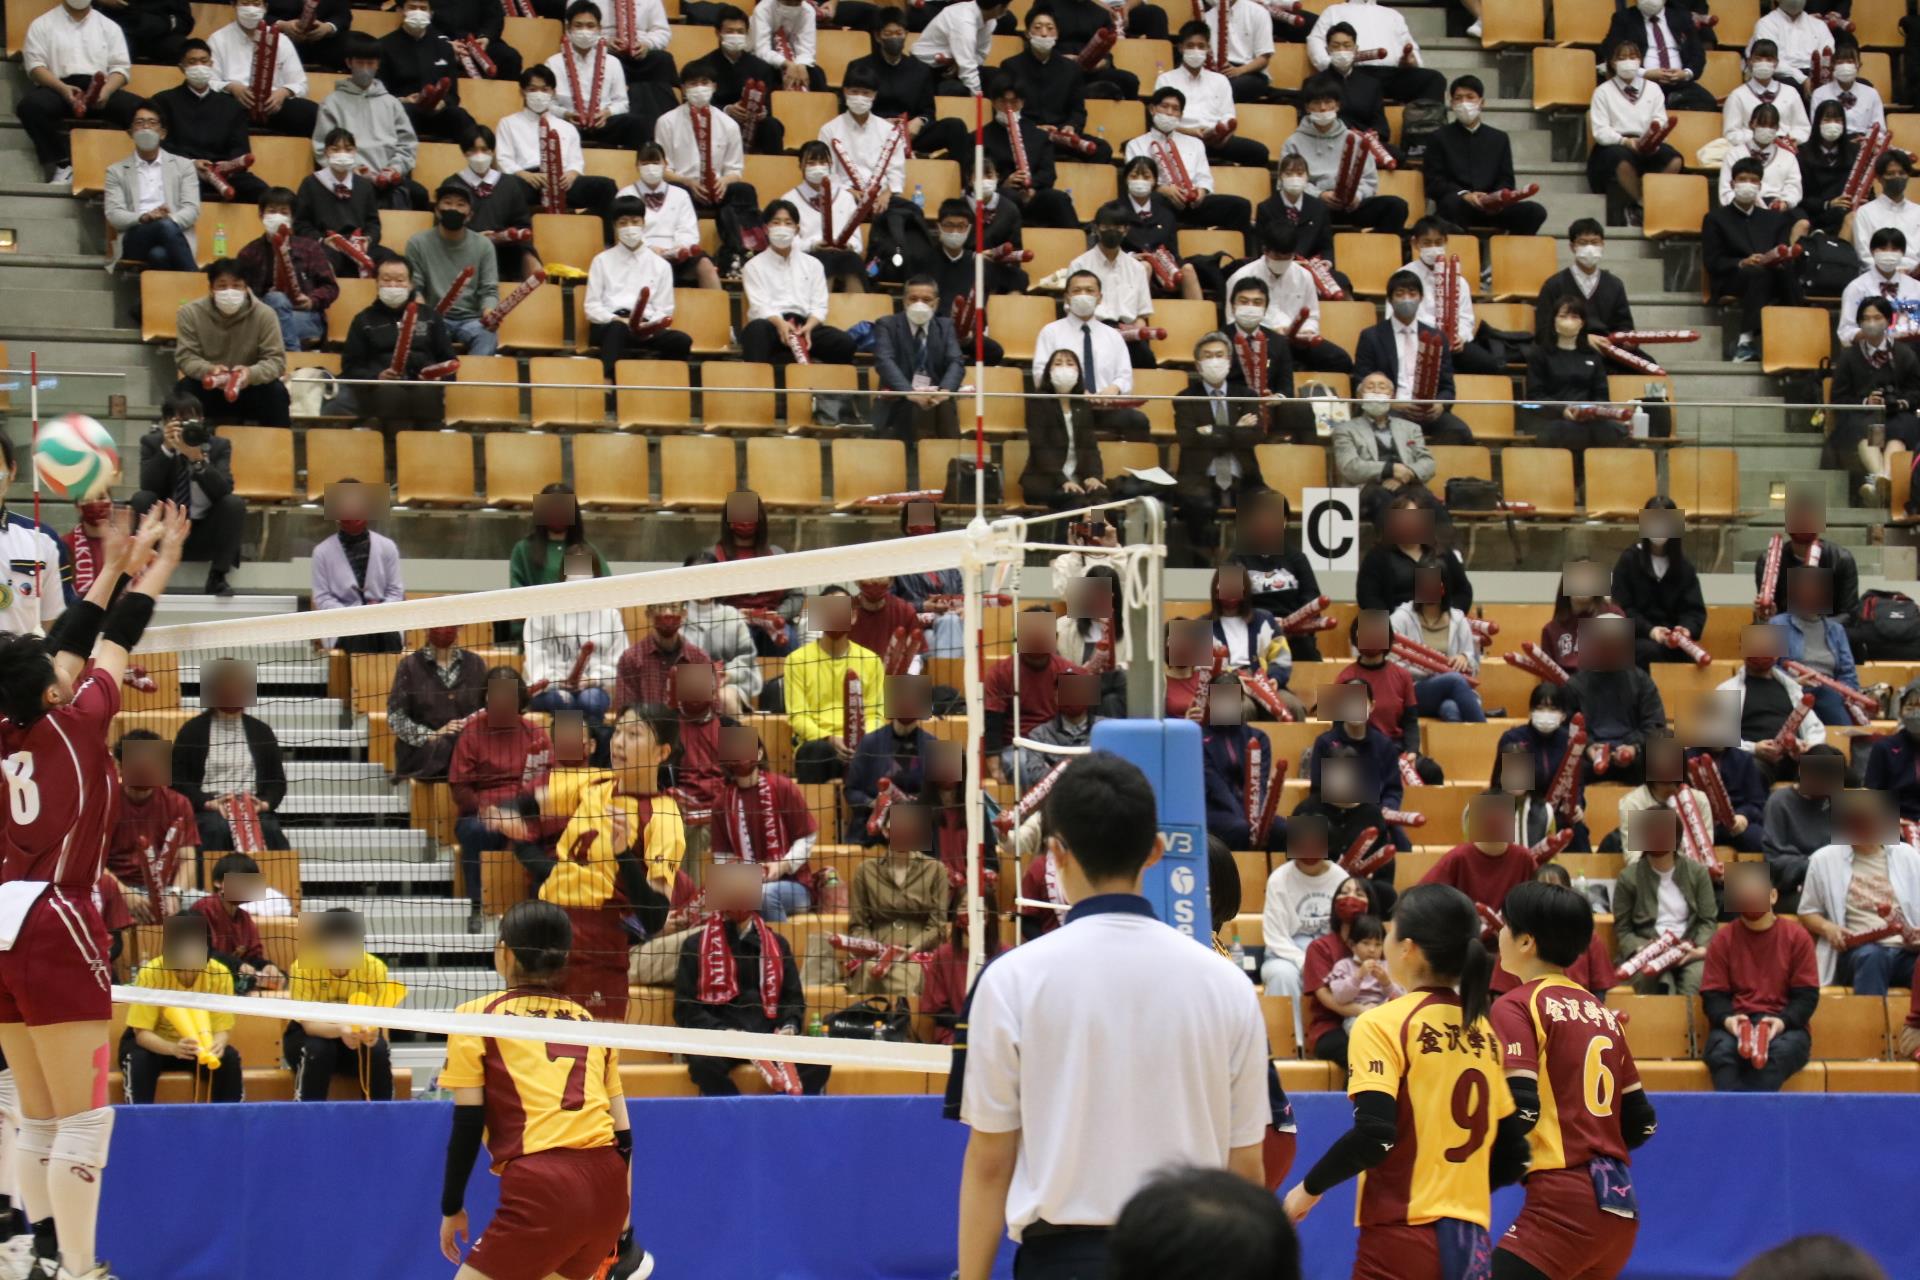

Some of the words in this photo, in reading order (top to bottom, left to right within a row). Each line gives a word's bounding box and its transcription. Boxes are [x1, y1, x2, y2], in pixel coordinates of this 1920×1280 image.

[1307, 500, 1354, 559] C
[1, 751, 40, 826] 8
[545, 1042, 589, 1111] 7
[1584, 1035, 1615, 1117] 6
[1444, 1067, 1490, 1163] 9
